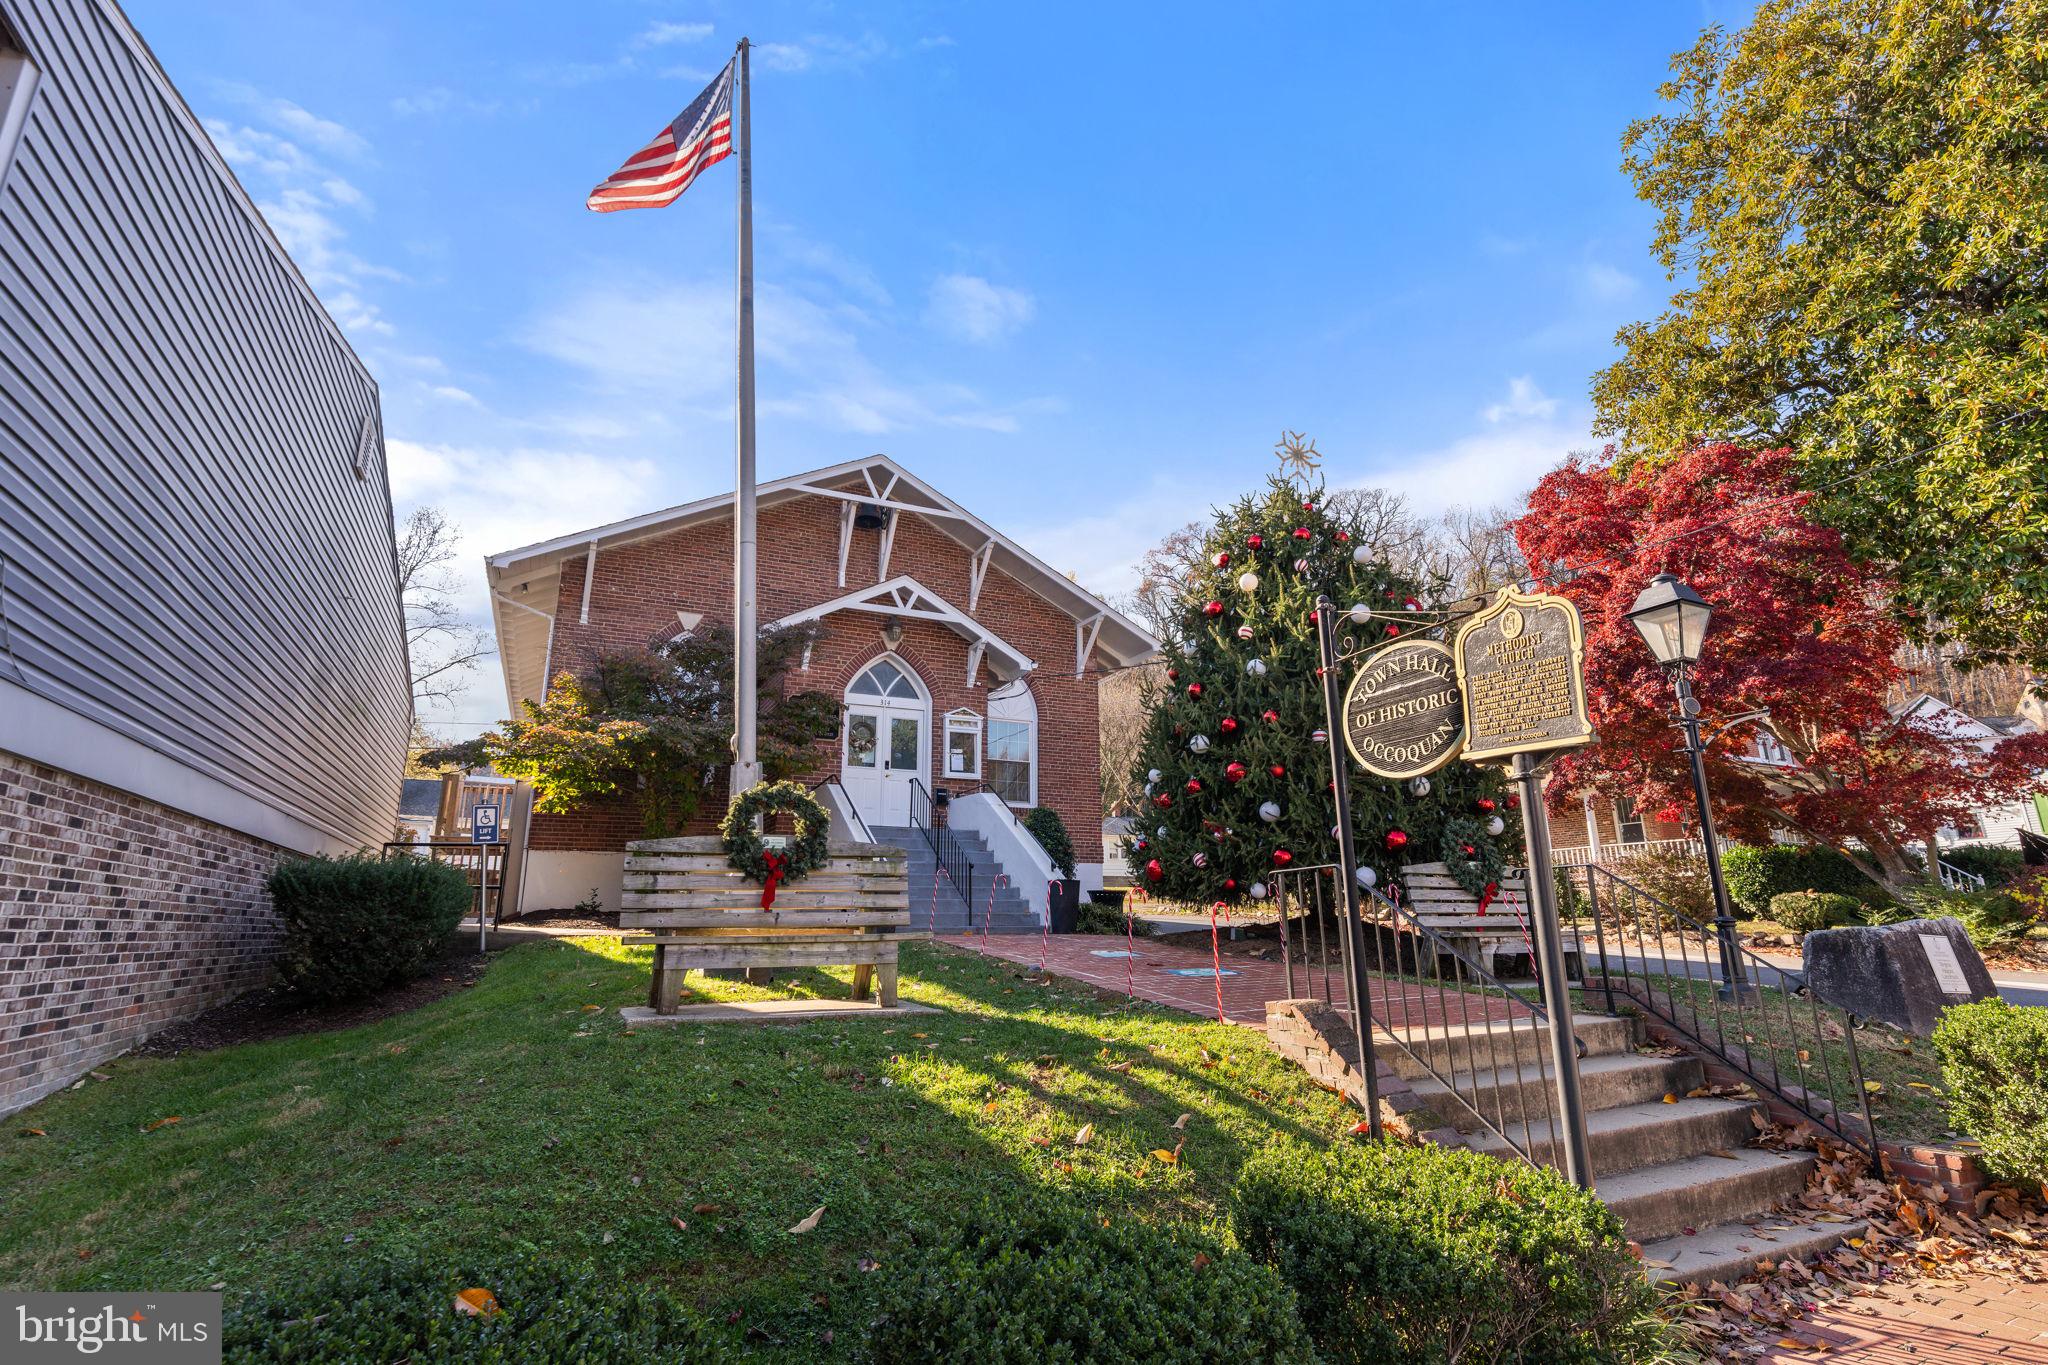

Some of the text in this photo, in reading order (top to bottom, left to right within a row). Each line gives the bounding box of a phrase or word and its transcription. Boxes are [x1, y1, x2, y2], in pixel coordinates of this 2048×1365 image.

[1487, 632, 1543, 657] METHODIST
[1497, 647, 1535, 666] CHURCH
[1356, 655, 1451, 704] TOWN HALL
[1357, 689, 1458, 728] OF HISTORIC
[1363, 718, 1454, 762] OCCOQUAN
